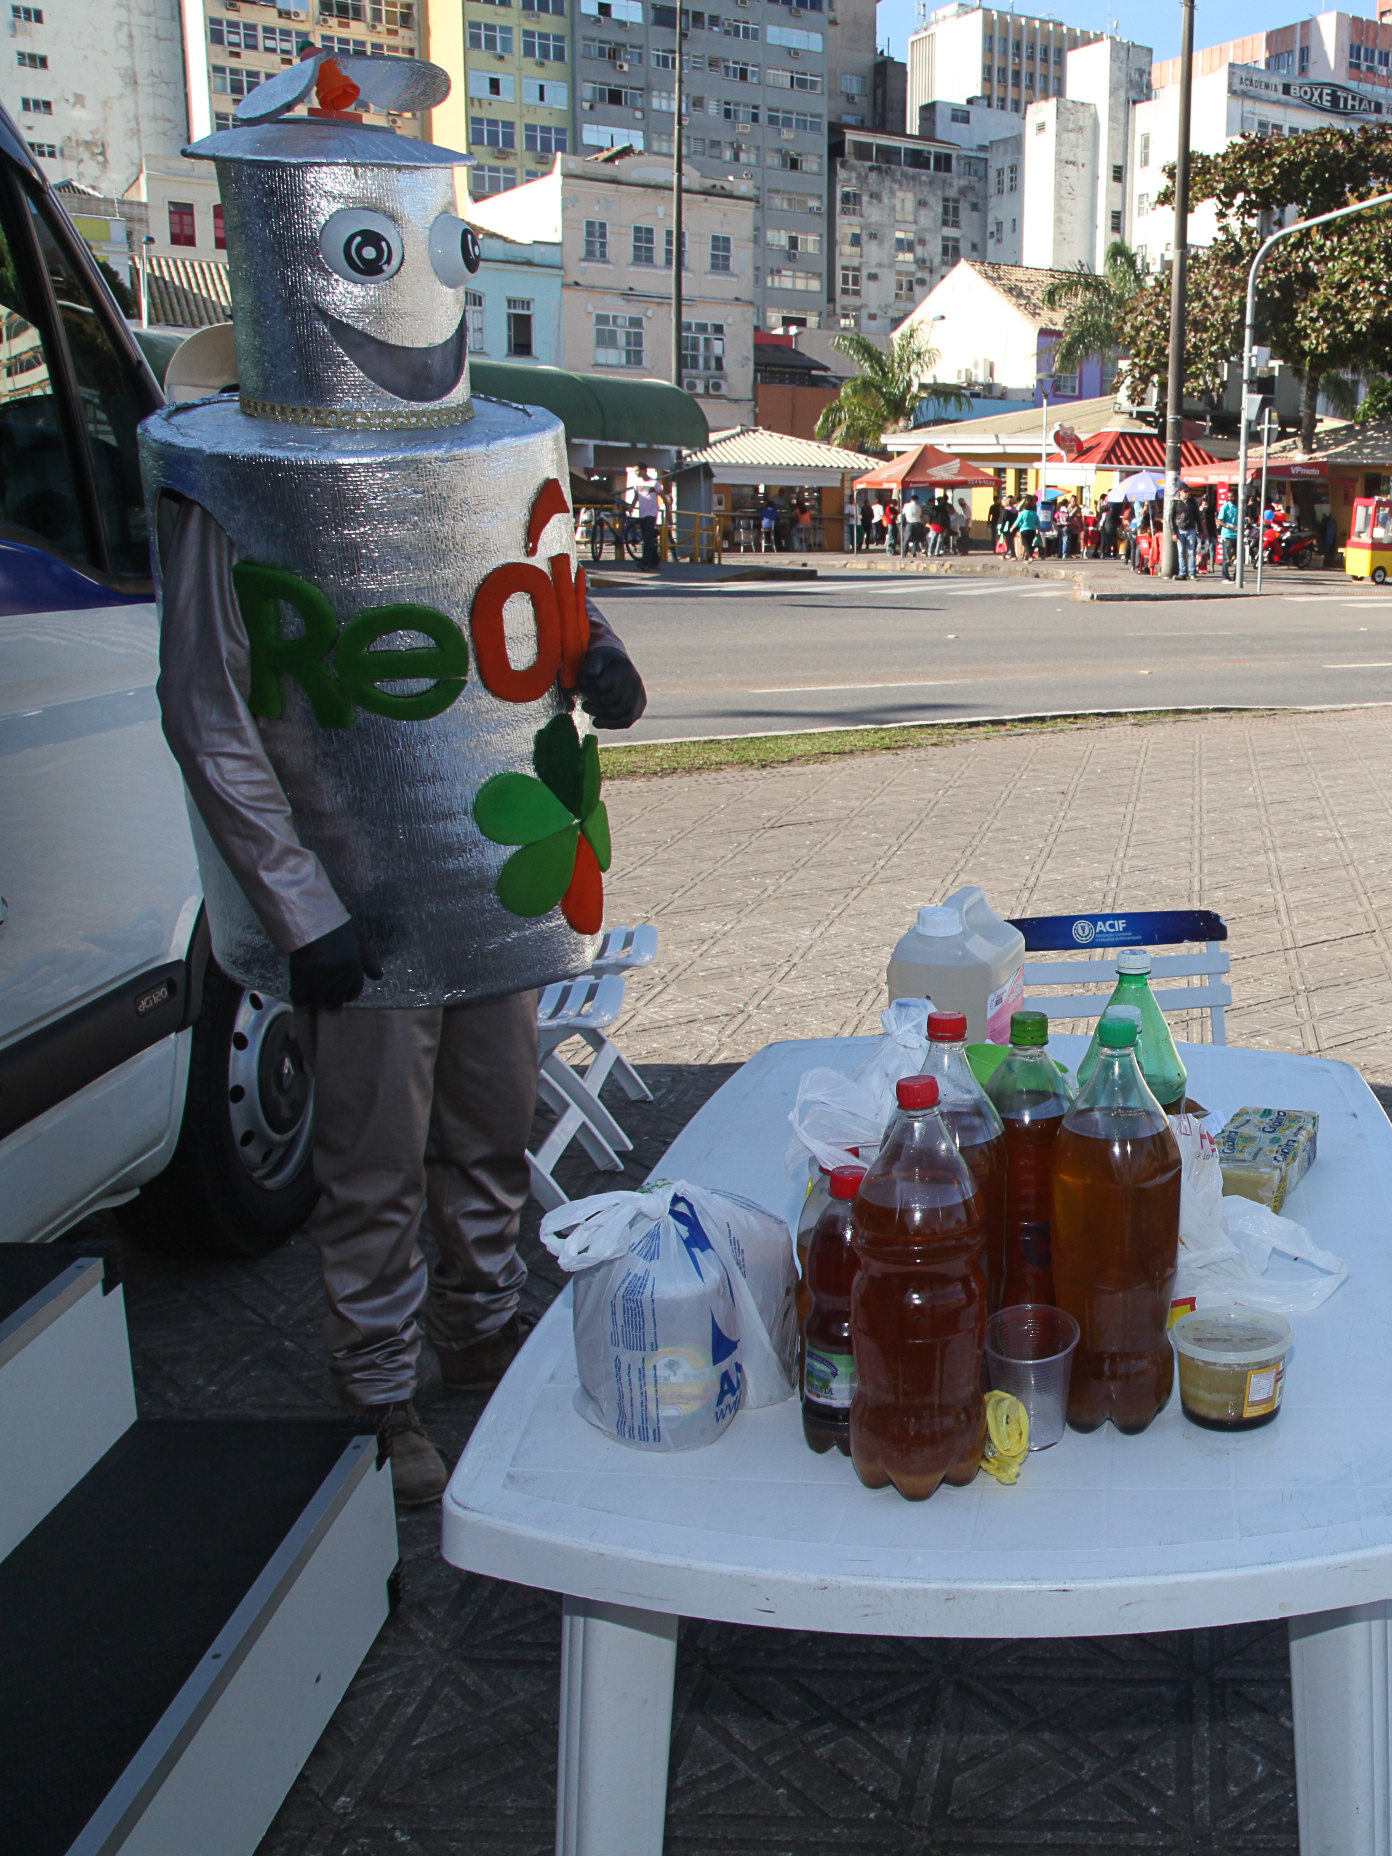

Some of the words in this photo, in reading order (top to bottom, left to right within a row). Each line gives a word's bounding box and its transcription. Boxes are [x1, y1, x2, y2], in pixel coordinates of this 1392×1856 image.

[1239, 76, 1279, 93] ACADEMIA
[1290, 85, 1331, 107] BOXE
[1336, 91, 1375, 112] THAI
[1095, 919, 1127, 933] ACIF
